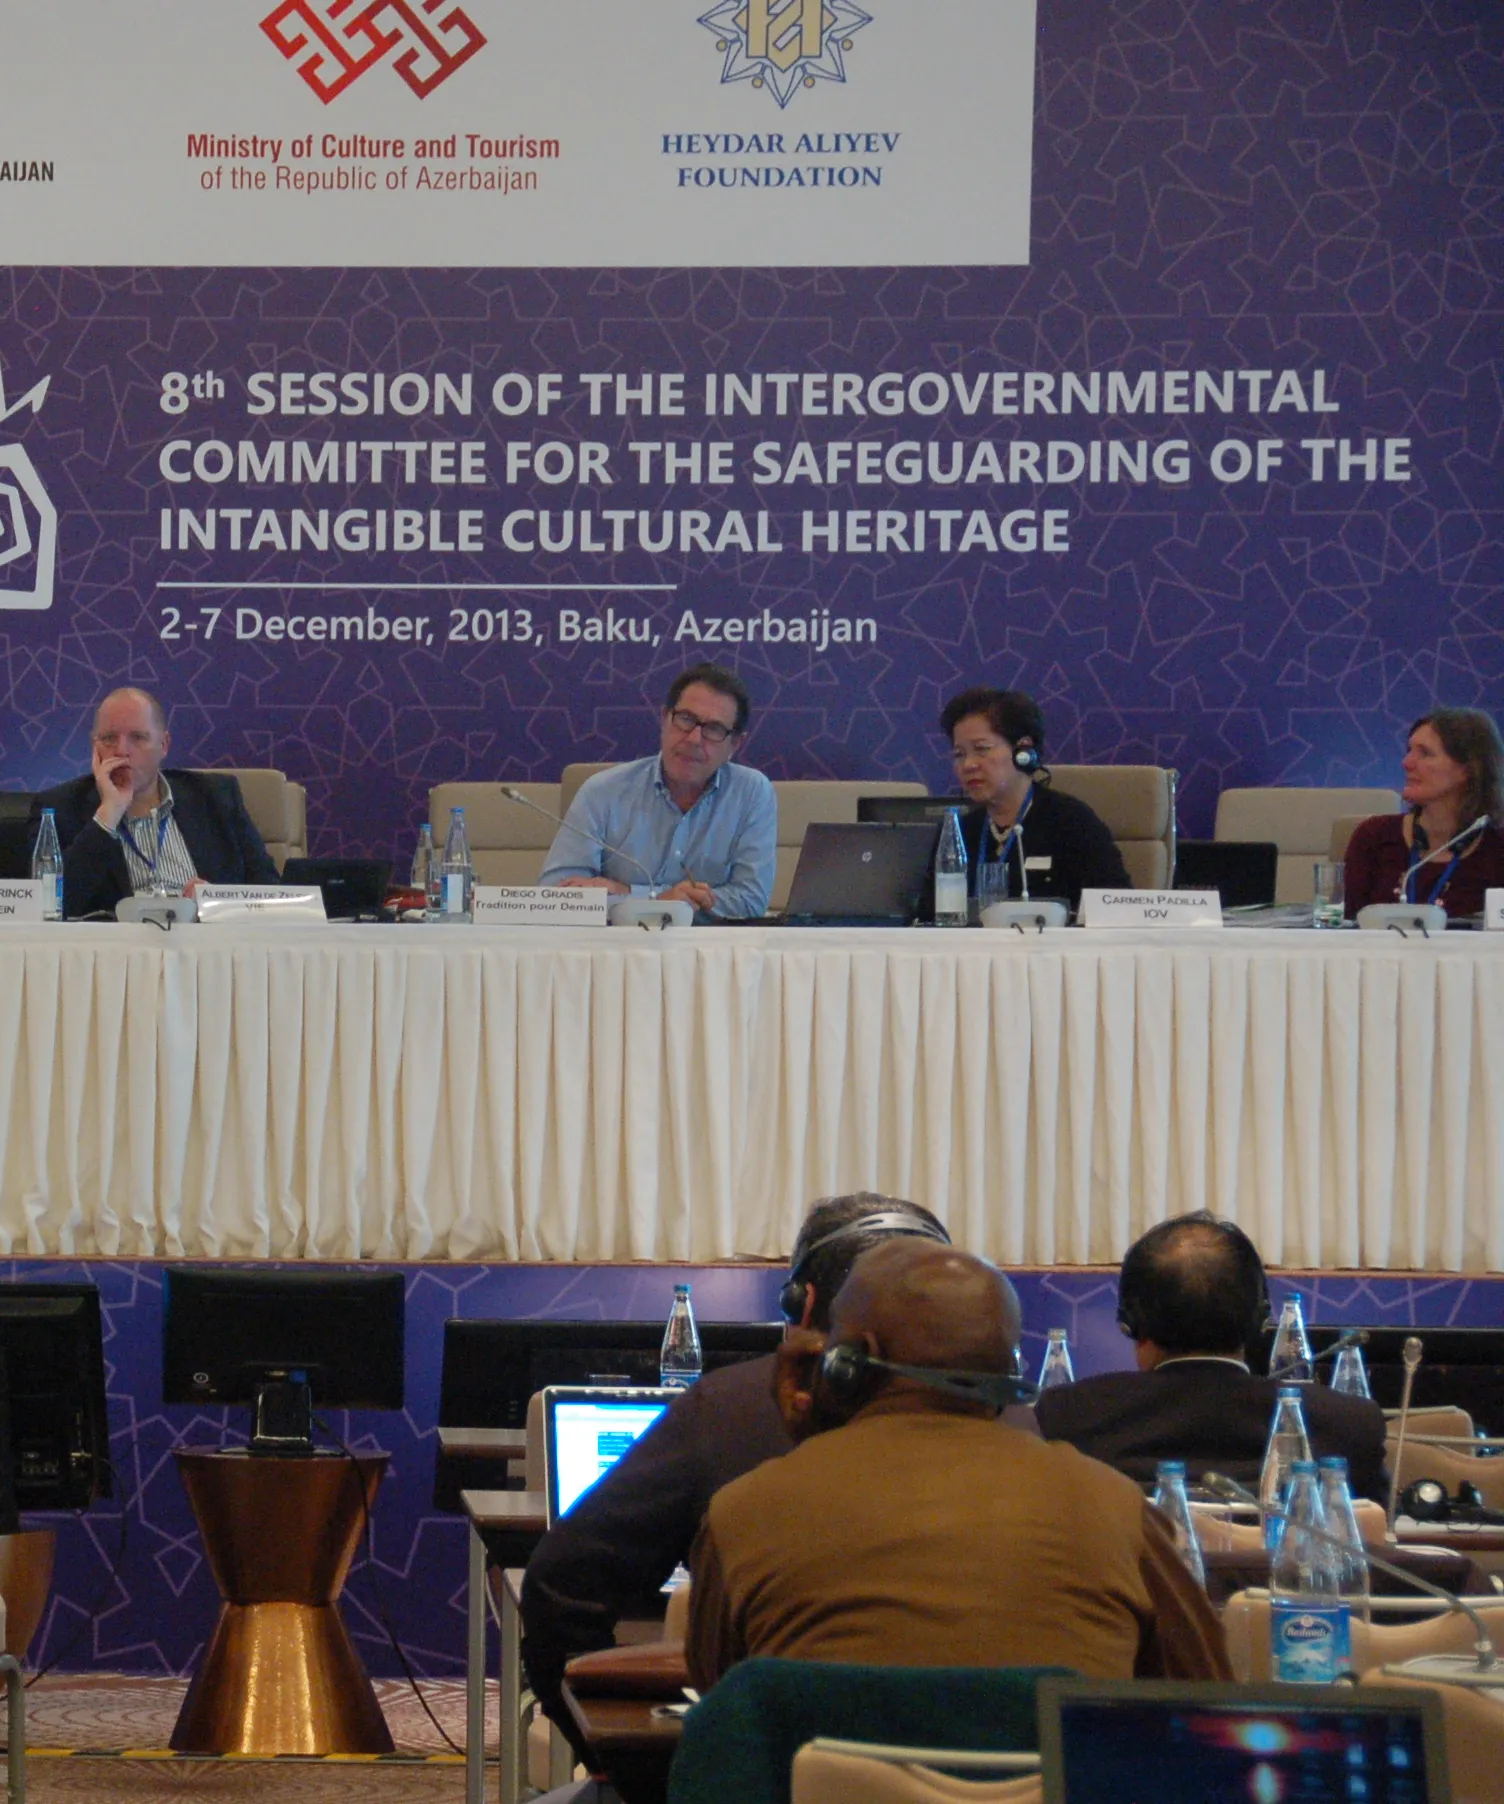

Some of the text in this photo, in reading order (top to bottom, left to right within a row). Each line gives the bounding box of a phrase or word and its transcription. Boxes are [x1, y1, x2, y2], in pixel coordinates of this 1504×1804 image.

[187, 133, 560, 164] Ministry of Culture and Tourism
[662, 132, 900, 154] HEYDAR ALIYEV
[200, 165, 537, 196] of the Republic of Azerbaijan
[677, 166, 882, 188] FOUNDATION
[159, 369, 1340, 417] 8th SESSION OF THE INTERGOVERNMENTAL
[158, 437, 1412, 485] COMMITTEE FOR THE SAFEGUARDING OF THE
[160, 508, 1070, 553] INTANGIBLE CULTURAL HERITAGE
[159, 606, 877, 653] 2-7 December, 2013, Baku, Azerbaijan
[530, 903, 556, 911] pour
[560, 902, 604, 912] Demain
